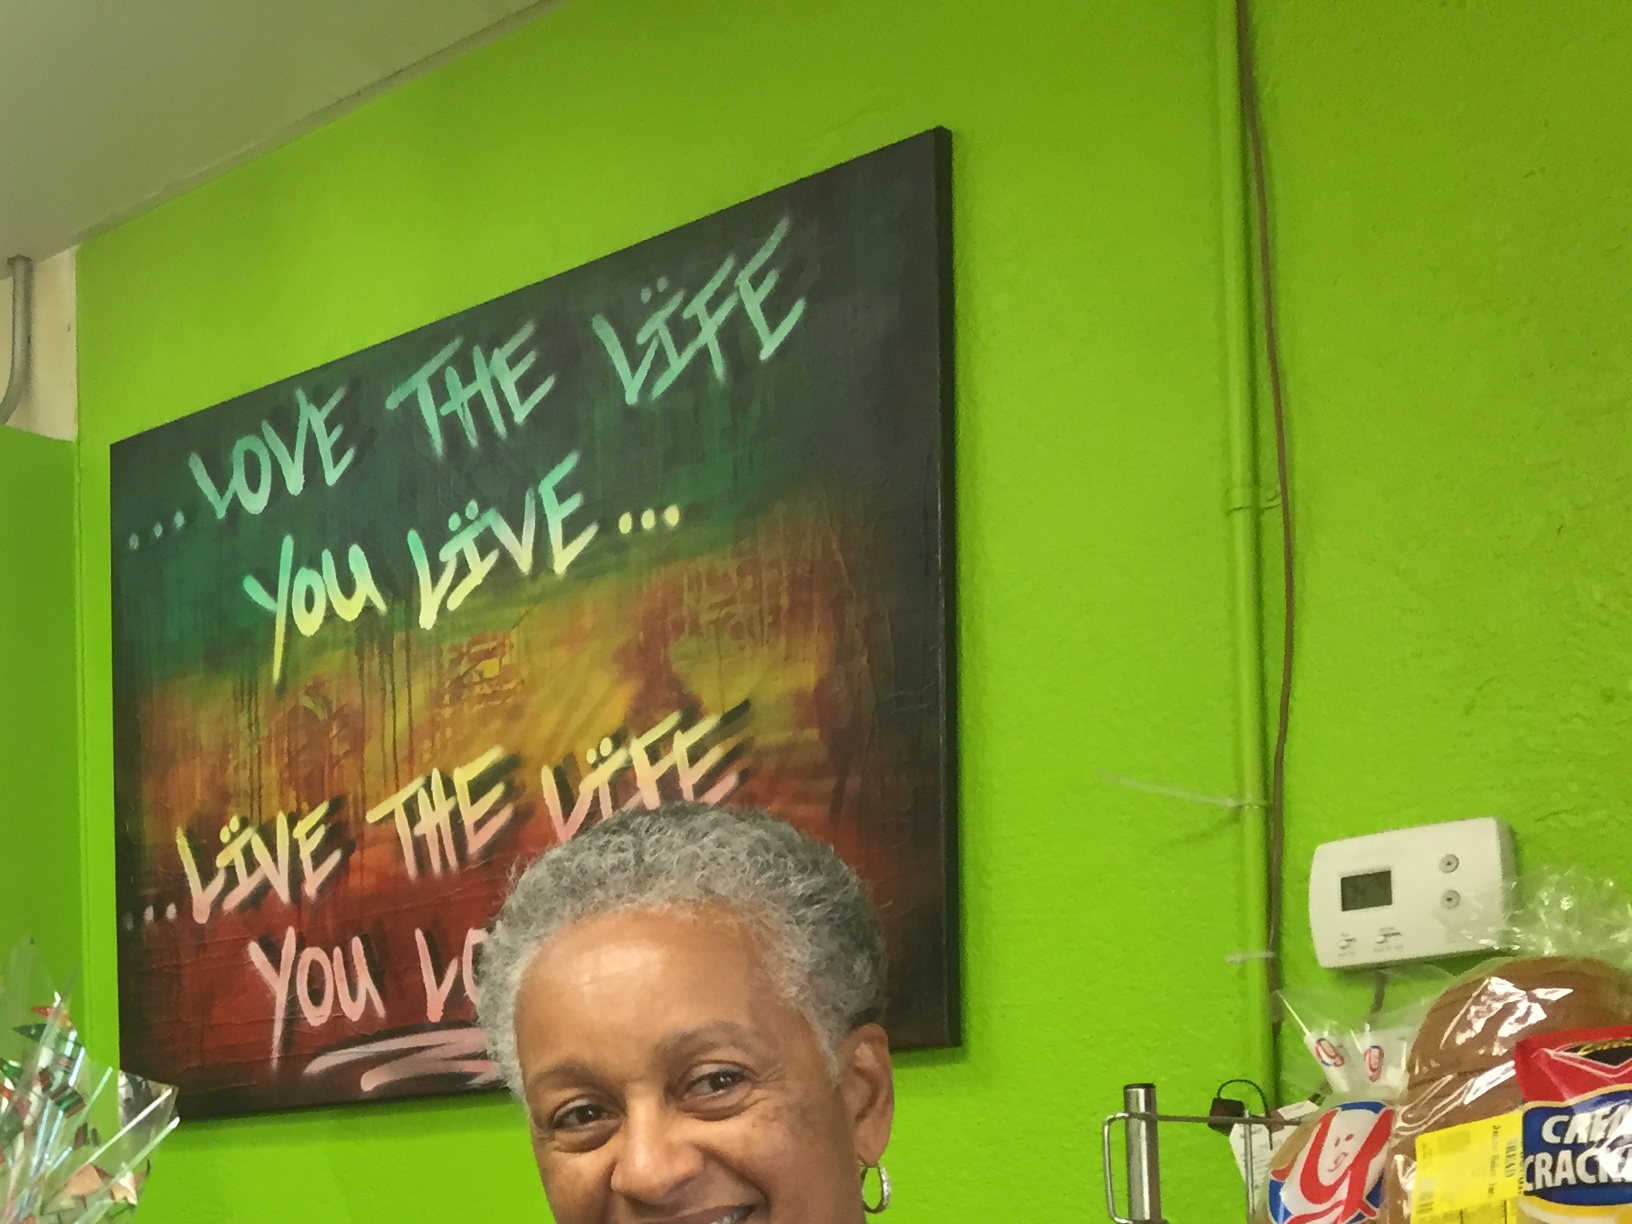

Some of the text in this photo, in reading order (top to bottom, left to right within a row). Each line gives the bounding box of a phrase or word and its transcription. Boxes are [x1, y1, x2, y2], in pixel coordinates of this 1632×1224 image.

[385, 320, 556, 460] THE
[242, 533, 387, 692] YOU
[366, 744, 518, 882] THE
[248, 925, 387, 1072] YOU
